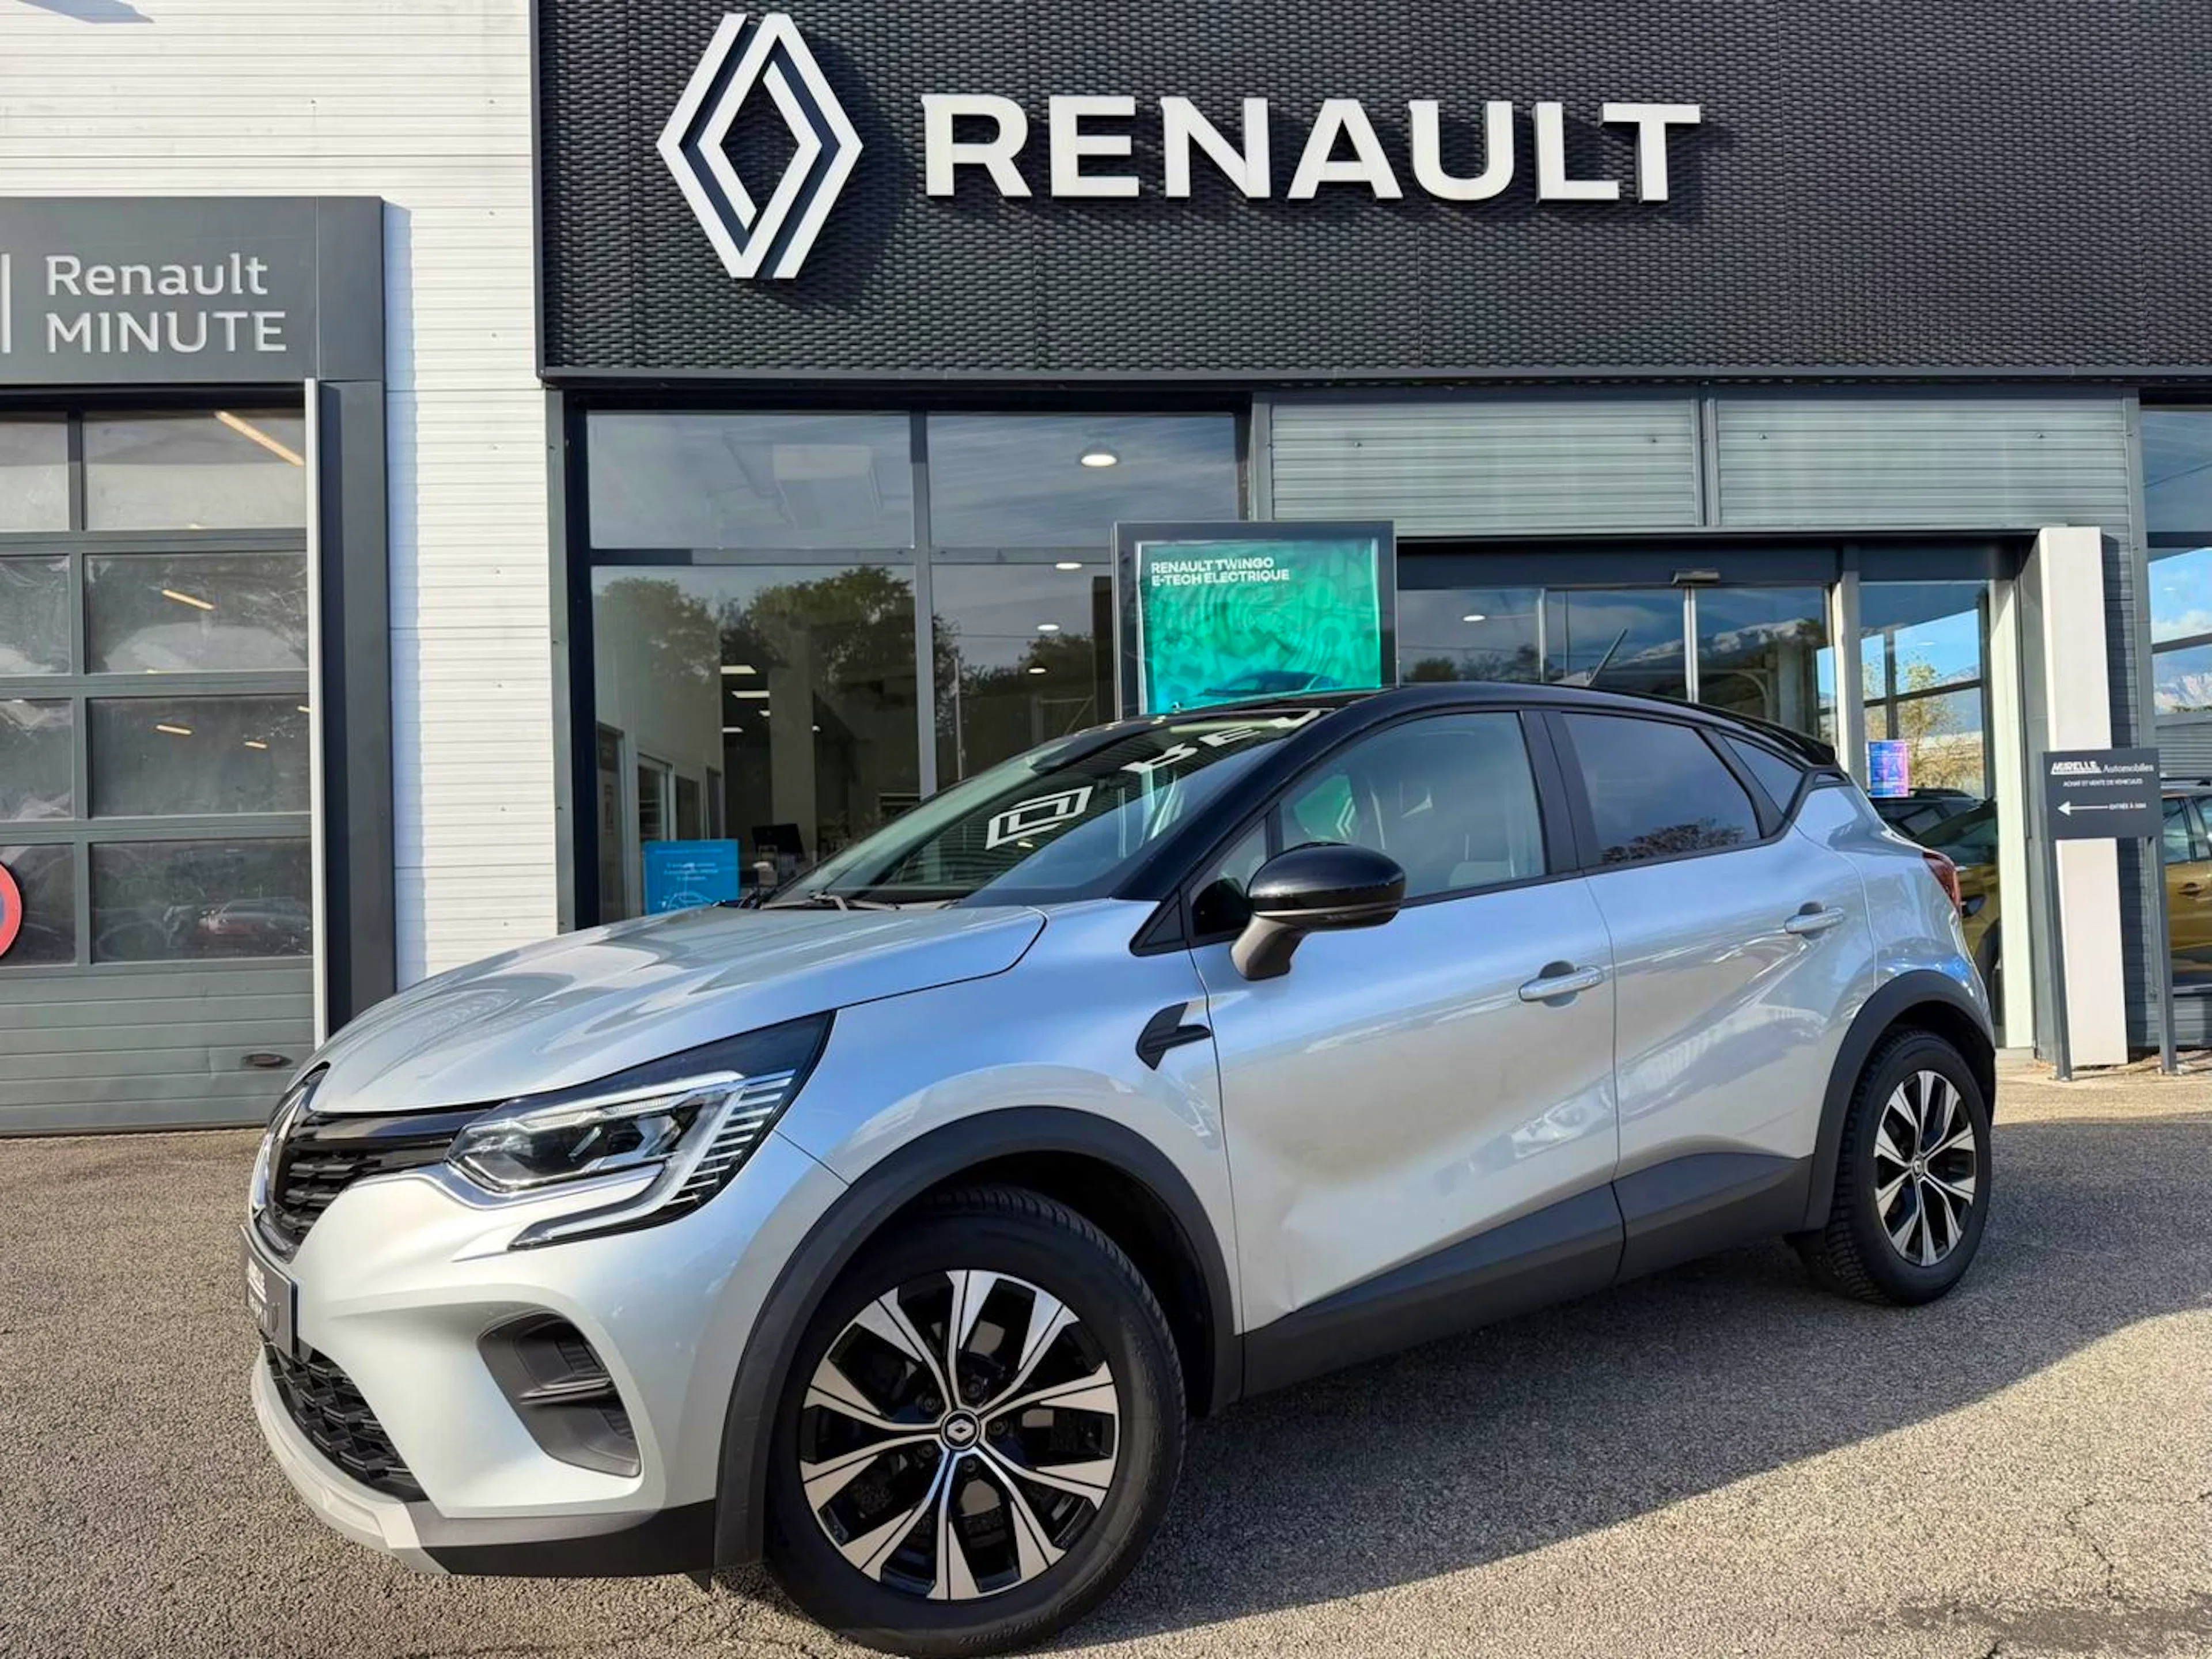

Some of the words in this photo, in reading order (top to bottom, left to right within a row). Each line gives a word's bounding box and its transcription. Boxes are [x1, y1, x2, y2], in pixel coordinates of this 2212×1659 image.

[921, 93, 1702, 203] RENAULT
[46, 253, 268, 296] Renault
[46, 311, 287, 354] MINUTE
[1151, 560, 1213, 574] RENAULT
[1214, 556, 1275, 570] TWINGO
[1152, 573, 1202, 586] E-TECH
[1204, 569, 1290, 583] ELECTRIQUE
[2103, 763, 2154, 773] Automobiles
